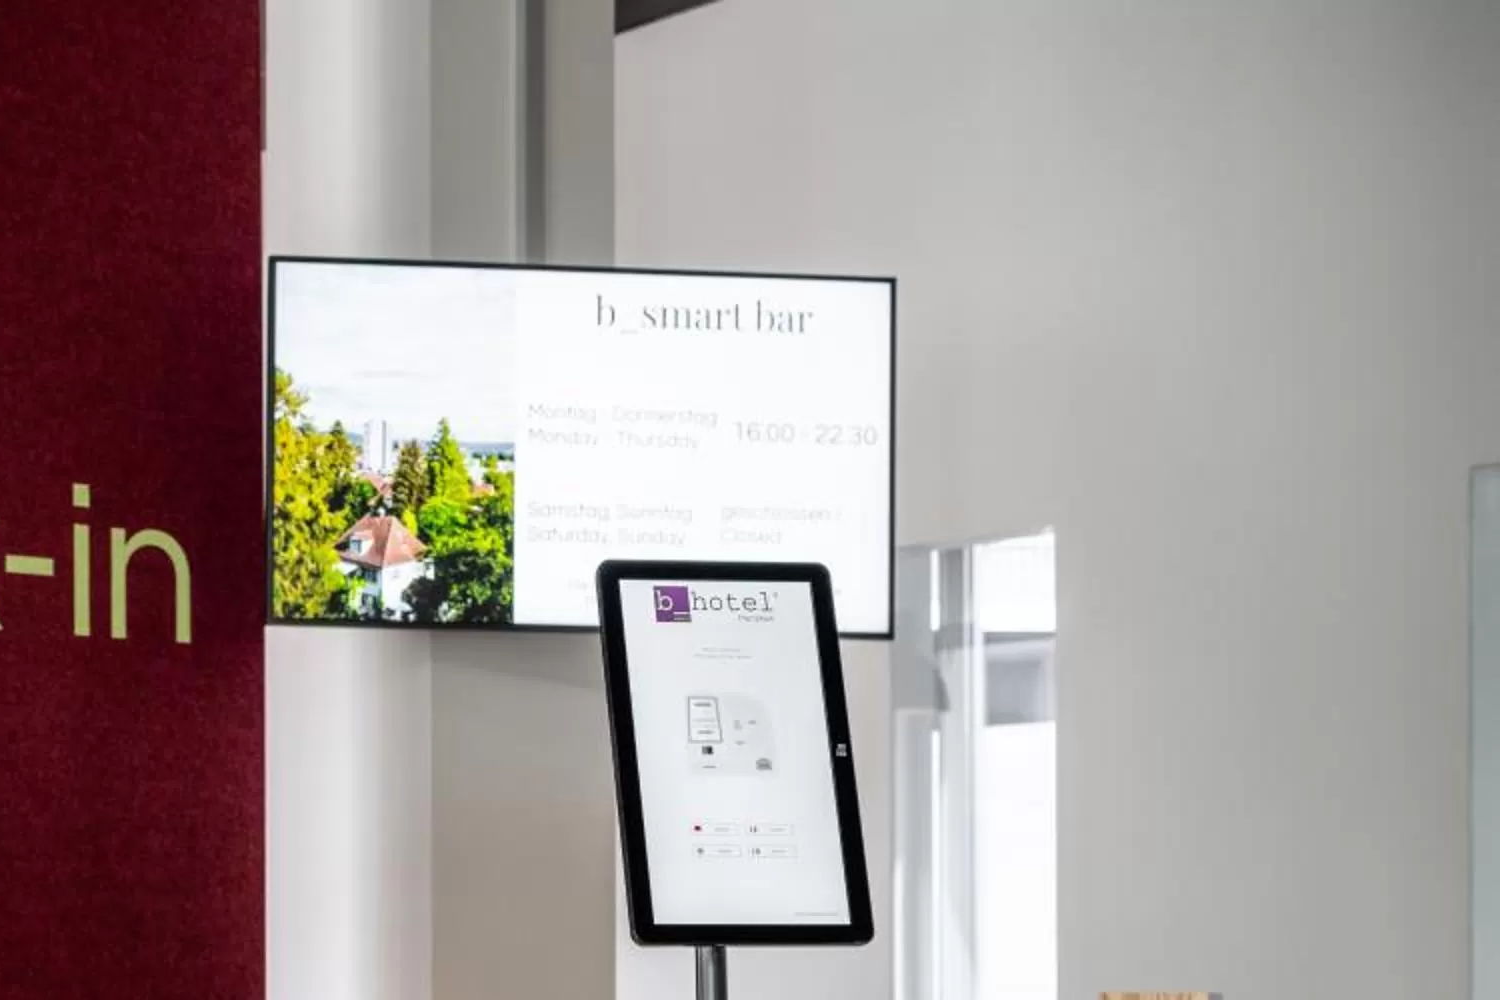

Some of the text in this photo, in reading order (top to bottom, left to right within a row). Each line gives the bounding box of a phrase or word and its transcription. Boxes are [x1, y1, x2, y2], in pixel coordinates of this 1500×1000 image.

[596, 293, 814, 334] b_smart bar
[527, 427, 699, 448] Monday Thursday
